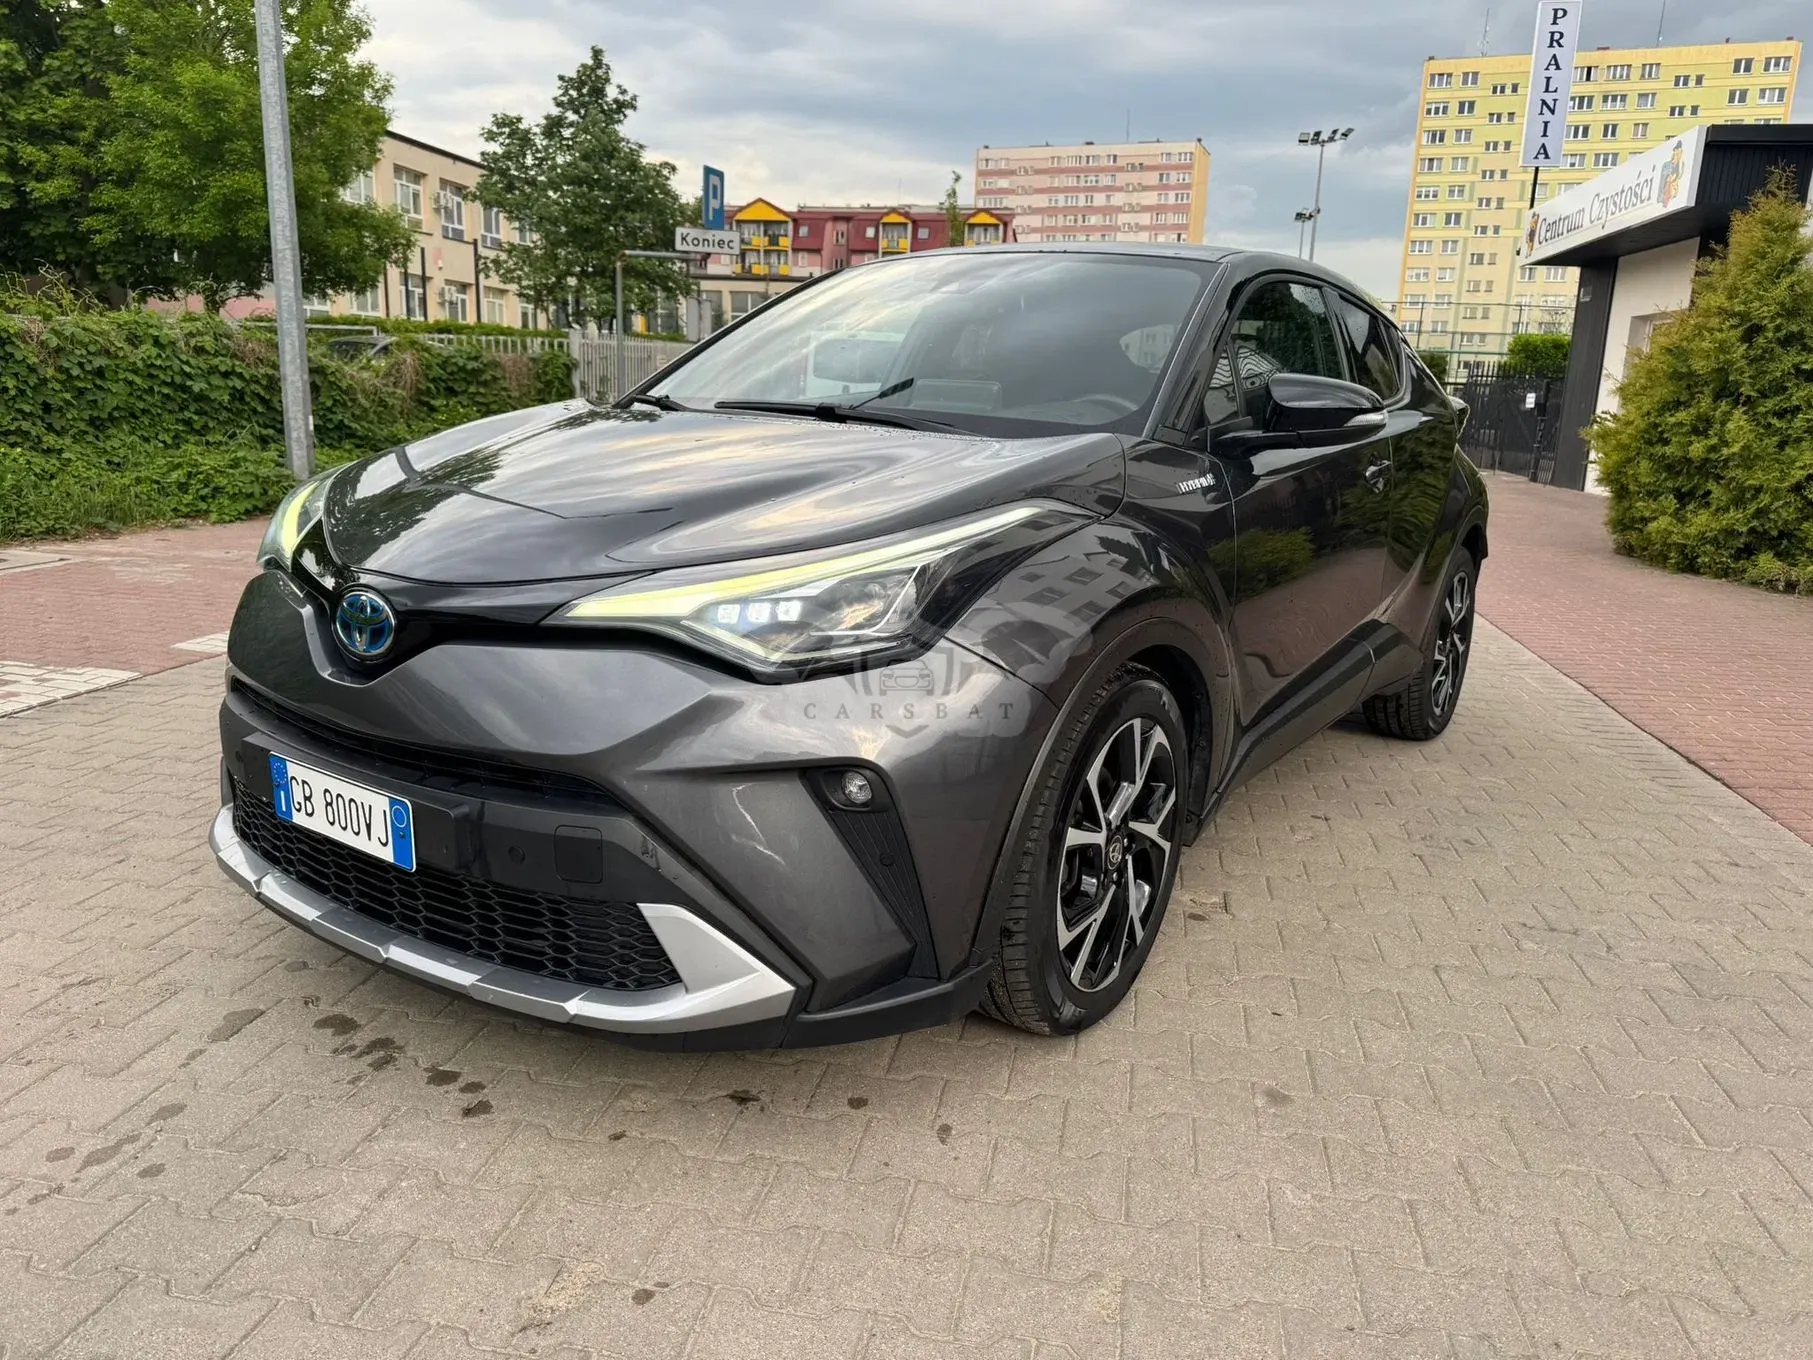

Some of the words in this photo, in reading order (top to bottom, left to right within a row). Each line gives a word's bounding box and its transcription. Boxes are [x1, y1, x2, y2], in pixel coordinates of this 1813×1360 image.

[1533, 8, 1568, 160] PRALNIA
[708, 174, 721, 221] P
[1538, 205, 1586, 245] Centrum
[1589, 164, 1656, 230] Czystości
[680, 232, 735, 250] Koniec
[289, 775, 315, 818] GB
[323, 788, 389, 847] 800VJ
